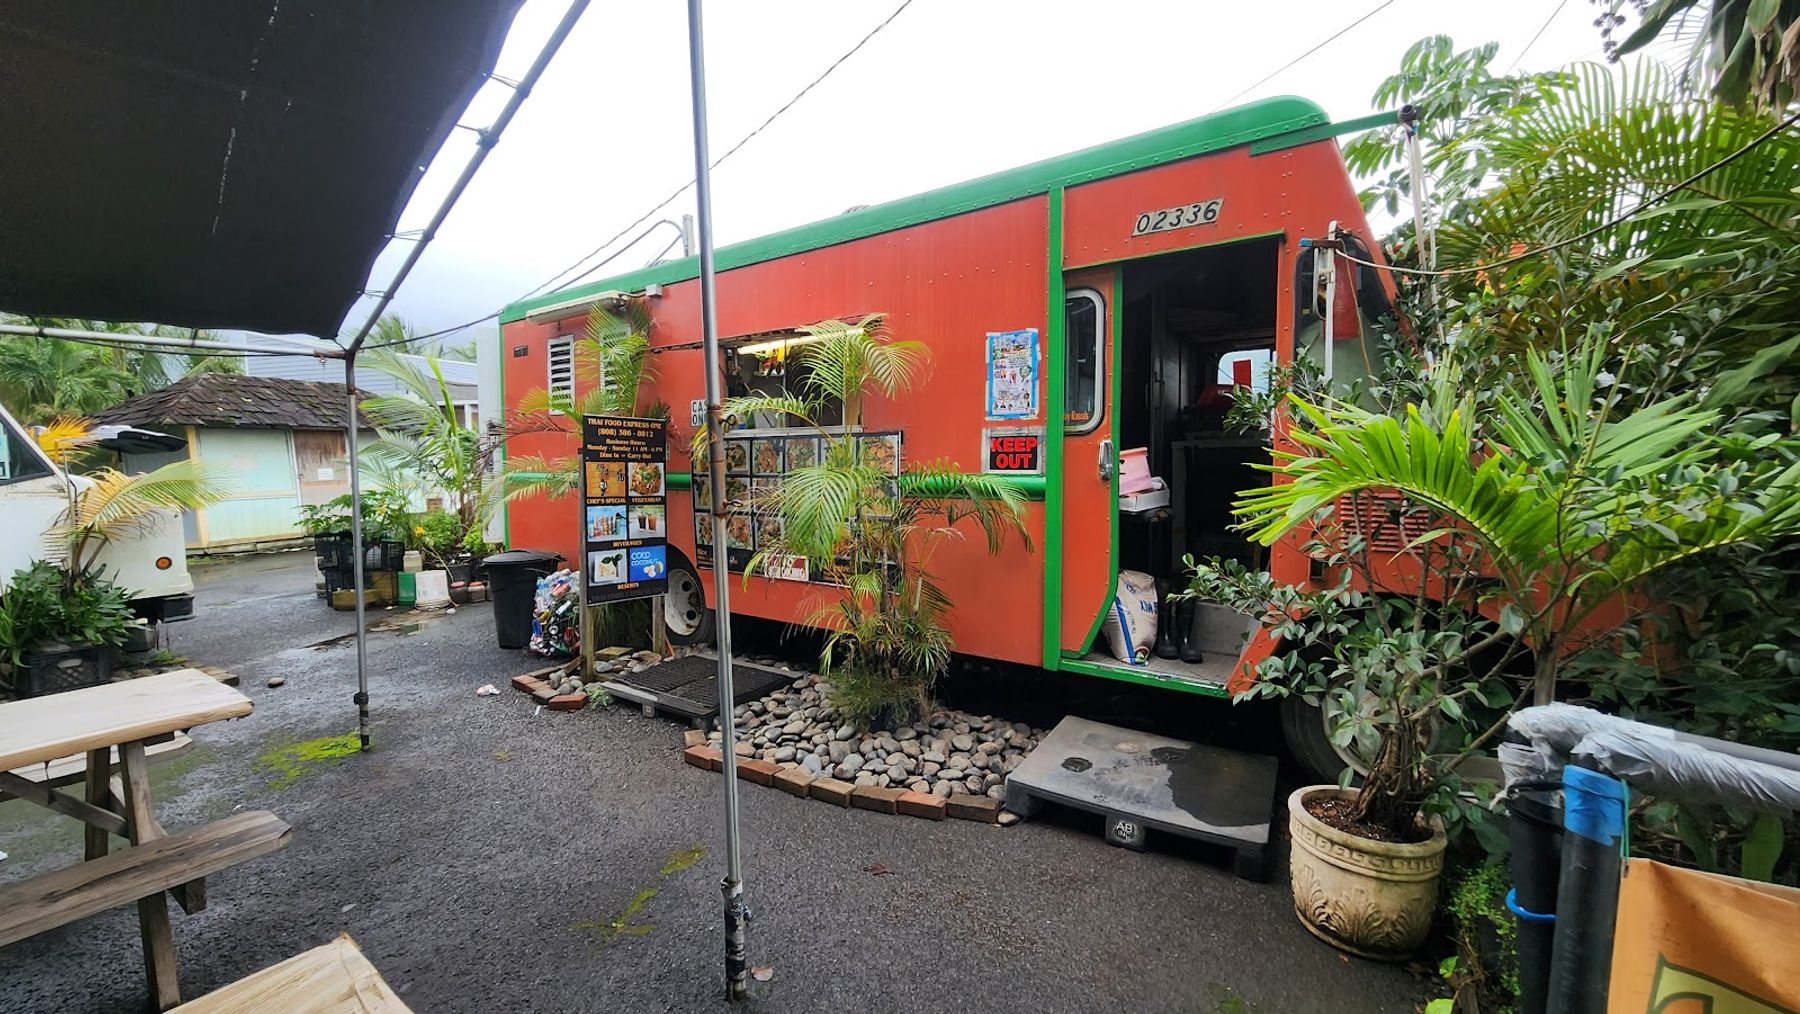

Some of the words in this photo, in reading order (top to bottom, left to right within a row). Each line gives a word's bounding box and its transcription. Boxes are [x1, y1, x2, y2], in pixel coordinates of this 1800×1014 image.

[1136, 200, 1220, 233] 02336
[588, 418, 603, 426] THAI
[604, 419, 622, 427] FOOD
[623, 420, 649, 429] EXPRESS
[586, 444, 607, 452] Monday
[612, 445, 631, 453] Sunday
[991, 436, 1038, 453] KEEP
[995, 453, 1033, 469] OUT
[631, 551, 651, 561] COLD
